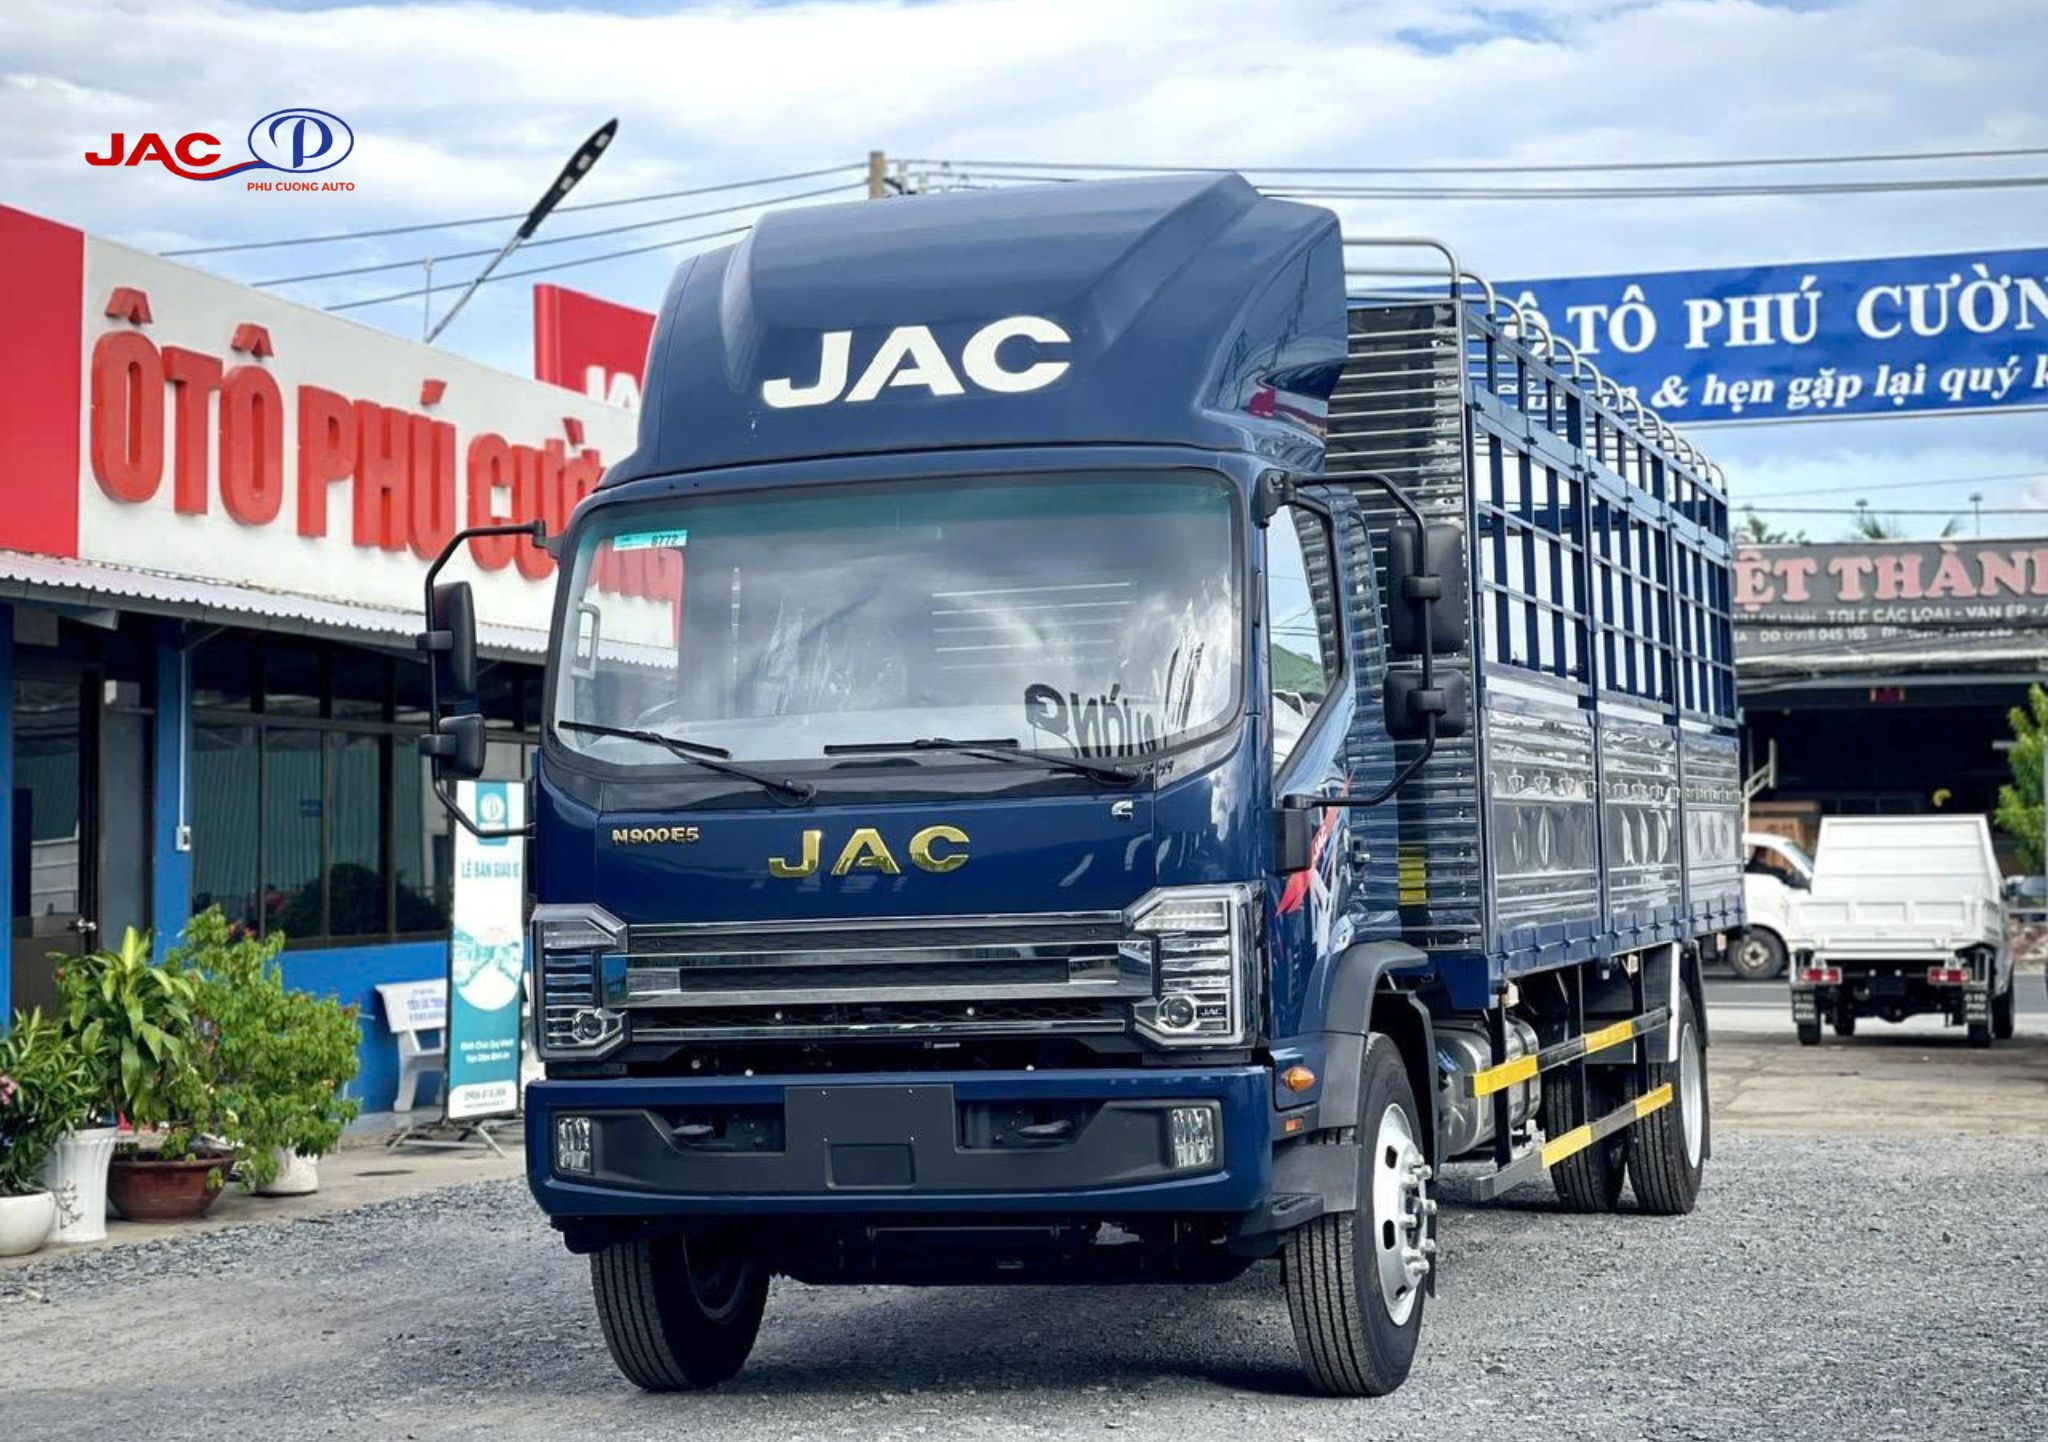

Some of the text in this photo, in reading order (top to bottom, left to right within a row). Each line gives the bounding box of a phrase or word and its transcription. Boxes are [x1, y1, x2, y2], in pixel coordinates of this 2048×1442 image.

[1566, 284, 1656, 354] TÔ
[1684, 276, 1822, 349] PHÚ
[762, 315, 1071, 408] JAC
[1651, 375, 1690, 408] &
[1702, 374, 1775, 413] hẹn
[1787, 368, 1863, 410] gặp
[1874, 364, 1927, 406] lại
[1939, 356, 2022, 400] quý
[297, 380, 455, 561] PHÚ
[612, 827, 700, 844] N900E5
[768, 825, 970, 879] JAC
